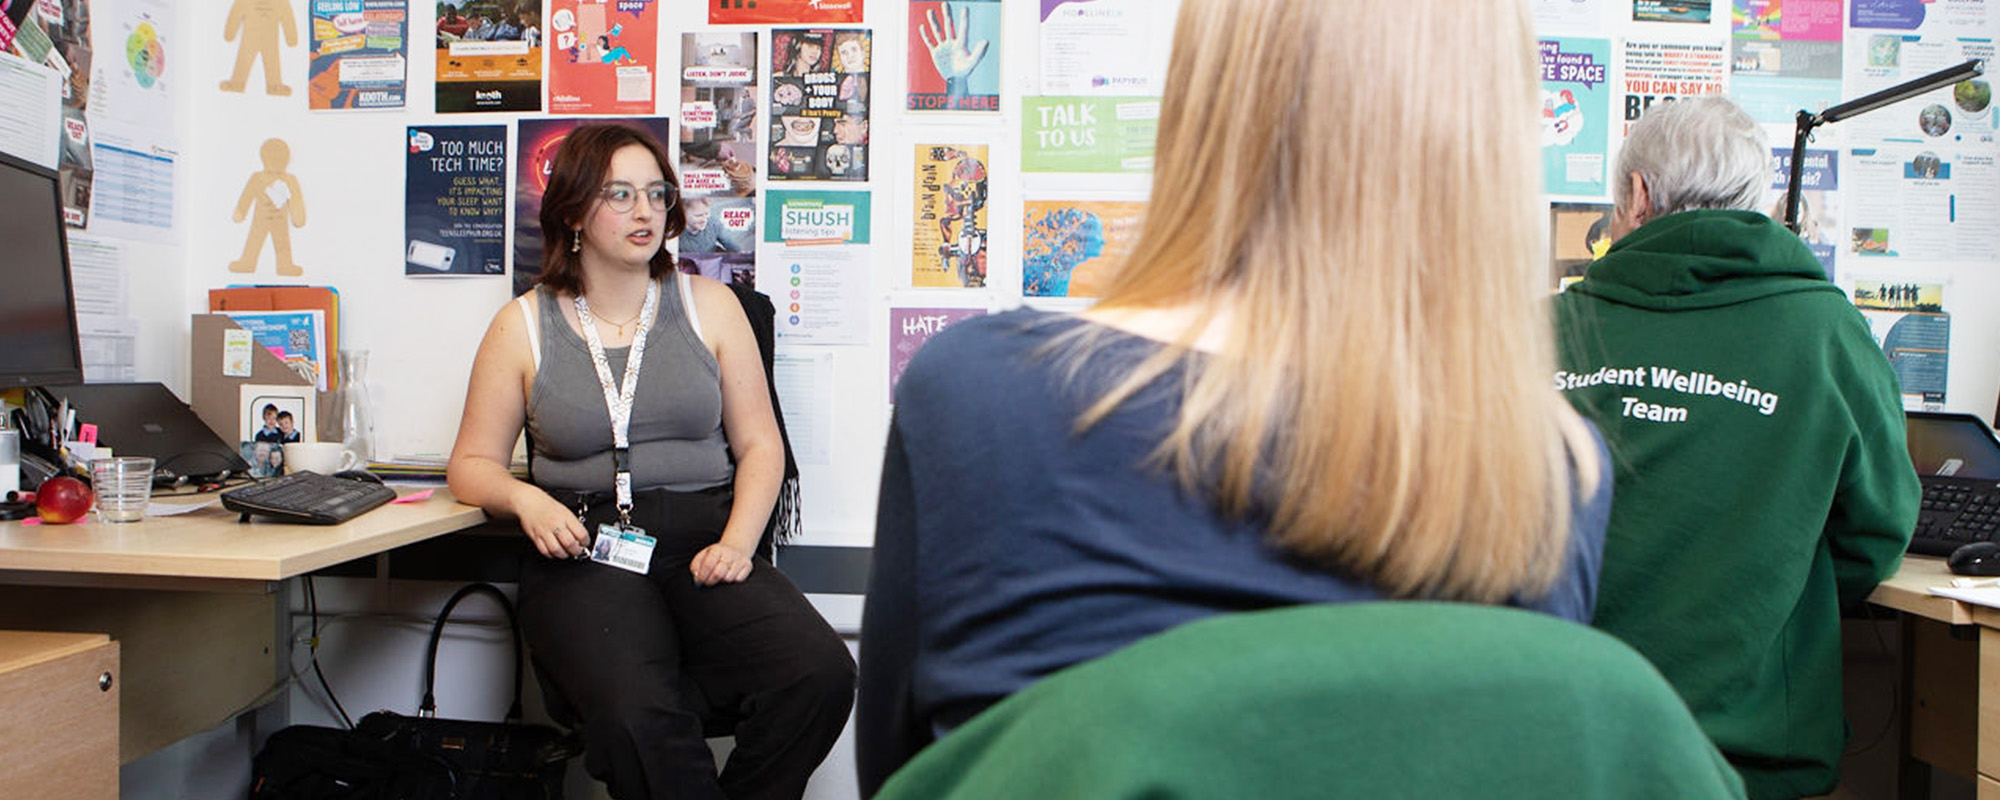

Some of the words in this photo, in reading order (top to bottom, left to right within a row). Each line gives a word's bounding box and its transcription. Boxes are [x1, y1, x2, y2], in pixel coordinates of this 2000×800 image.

[618, 2, 644, 11] space
[818, 2, 852, 10] Stonewall
[1557, 54, 1583, 64] found
[1584, 57, 1591, 65] a
[804, 72, 837, 84] DRUGS
[1560, 65, 1604, 82] SPACE
[812, 85, 838, 96] YOUR
[1625, 81, 1649, 93] YOU
[1653, 81, 1677, 94] CAN
[1681, 82, 1702, 95] SAY
[1706, 84, 1722, 95] NO
[808, 96, 834, 109] BODY
[907, 94, 956, 109] STOPS
[958, 95, 998, 110] HERE
[1037, 103, 1096, 128] TALK
[1036, 129, 1065, 149] TO
[1070, 128, 1096, 147] US
[440, 140, 464, 156] TOO
[468, 140, 504, 155] MUCH
[430, 157, 462, 172] TECH
[467, 156, 504, 172] TIME?
[453, 176, 477, 186] GUESS
[464, 186, 503, 196] IMPACTING
[436, 196, 455, 206] YOUR
[482, 197, 503, 206] WANT
[449, 206, 457, 216] TO
[460, 207, 480, 216] KNOW
[483, 207, 503, 216] WHY?
[724, 211, 751, 219] REACH
[728, 219, 745, 227] OUT
[786, 210, 849, 227] SHUSH
[785, 227, 818, 237] listening
[820, 228, 836, 237] tips
[902, 315, 948, 336] HATE
[1553, 366, 1647, 390] Student
[1650, 366, 1779, 415] Wellbeing
[1621, 397, 1688, 422] Team
